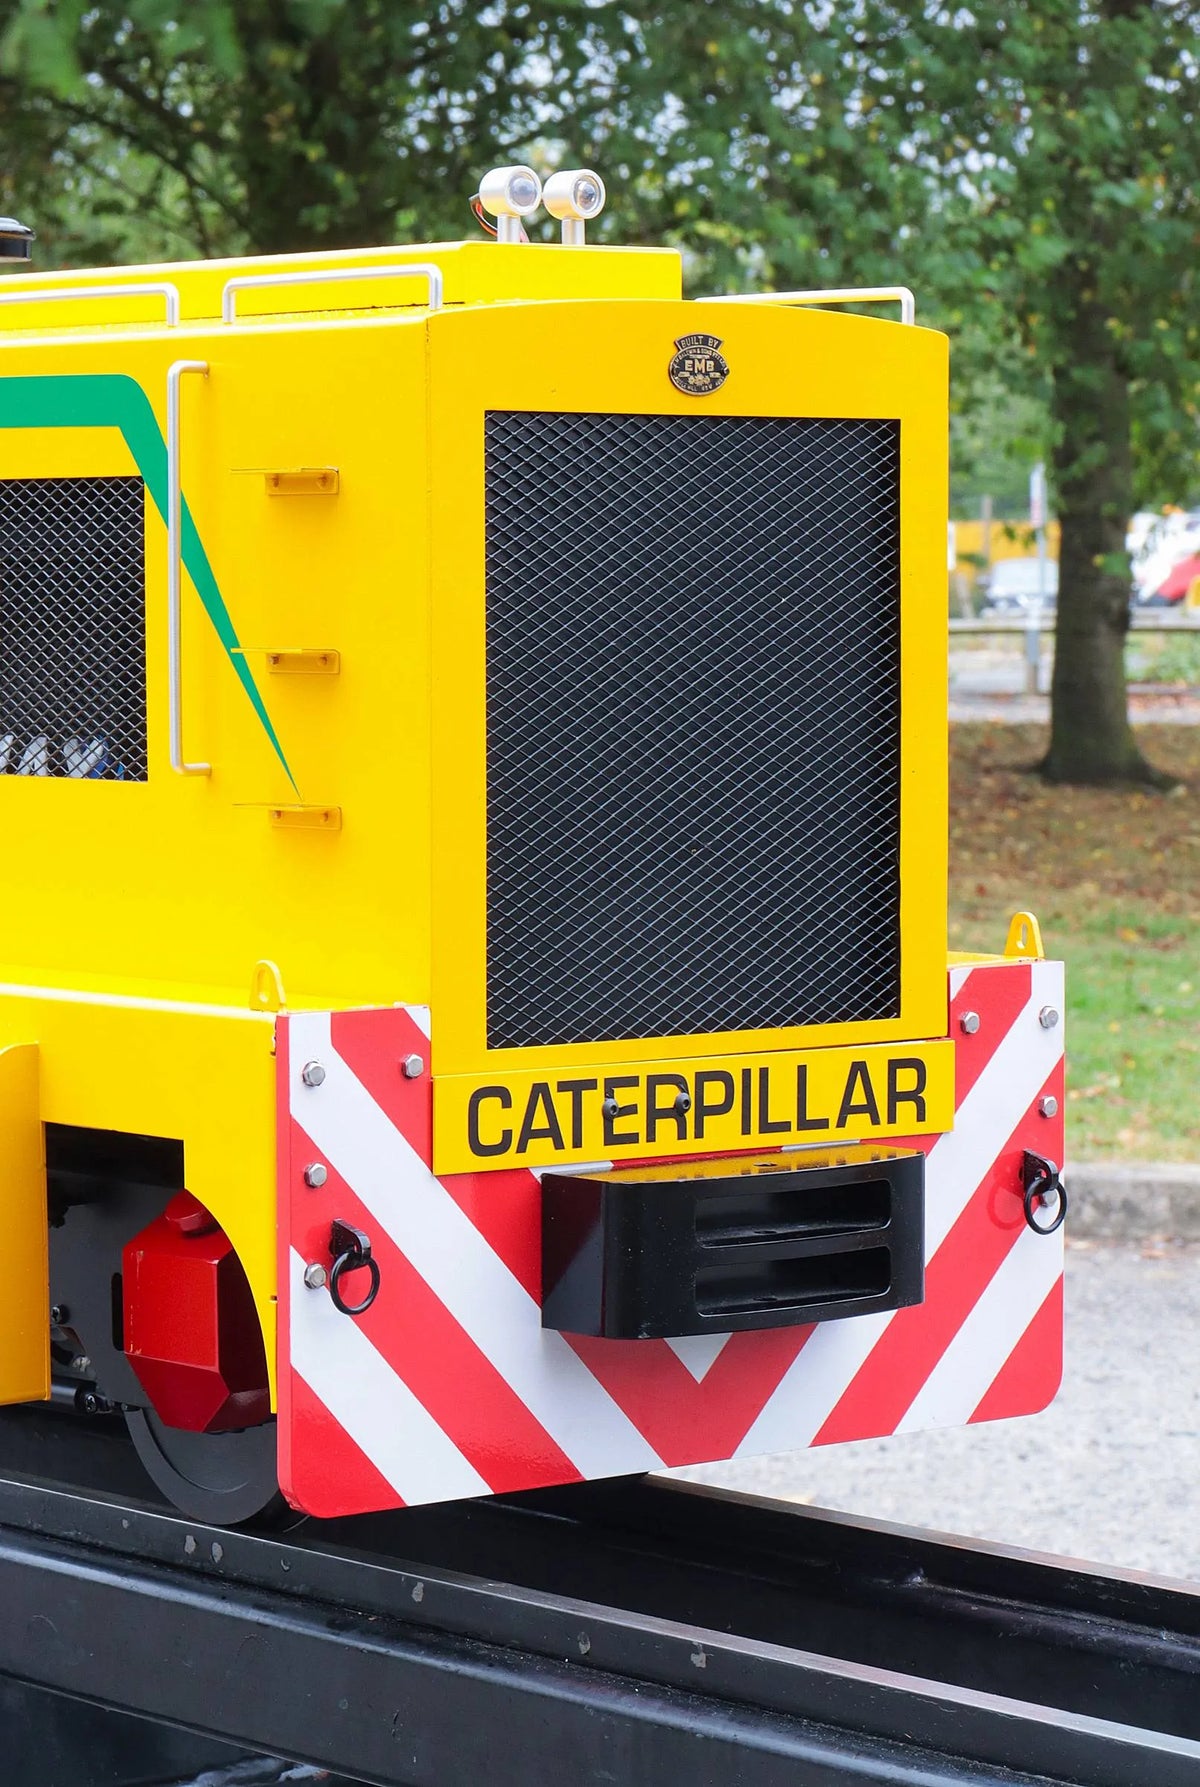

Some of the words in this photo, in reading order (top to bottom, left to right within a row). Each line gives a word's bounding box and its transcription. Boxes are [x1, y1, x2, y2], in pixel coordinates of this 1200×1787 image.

[681, 336, 703, 348] BUILT
[708, 337, 719, 348] BY
[684, 359, 715, 373] EMB
[467, 1057, 927, 1158] CATERPILLAR
